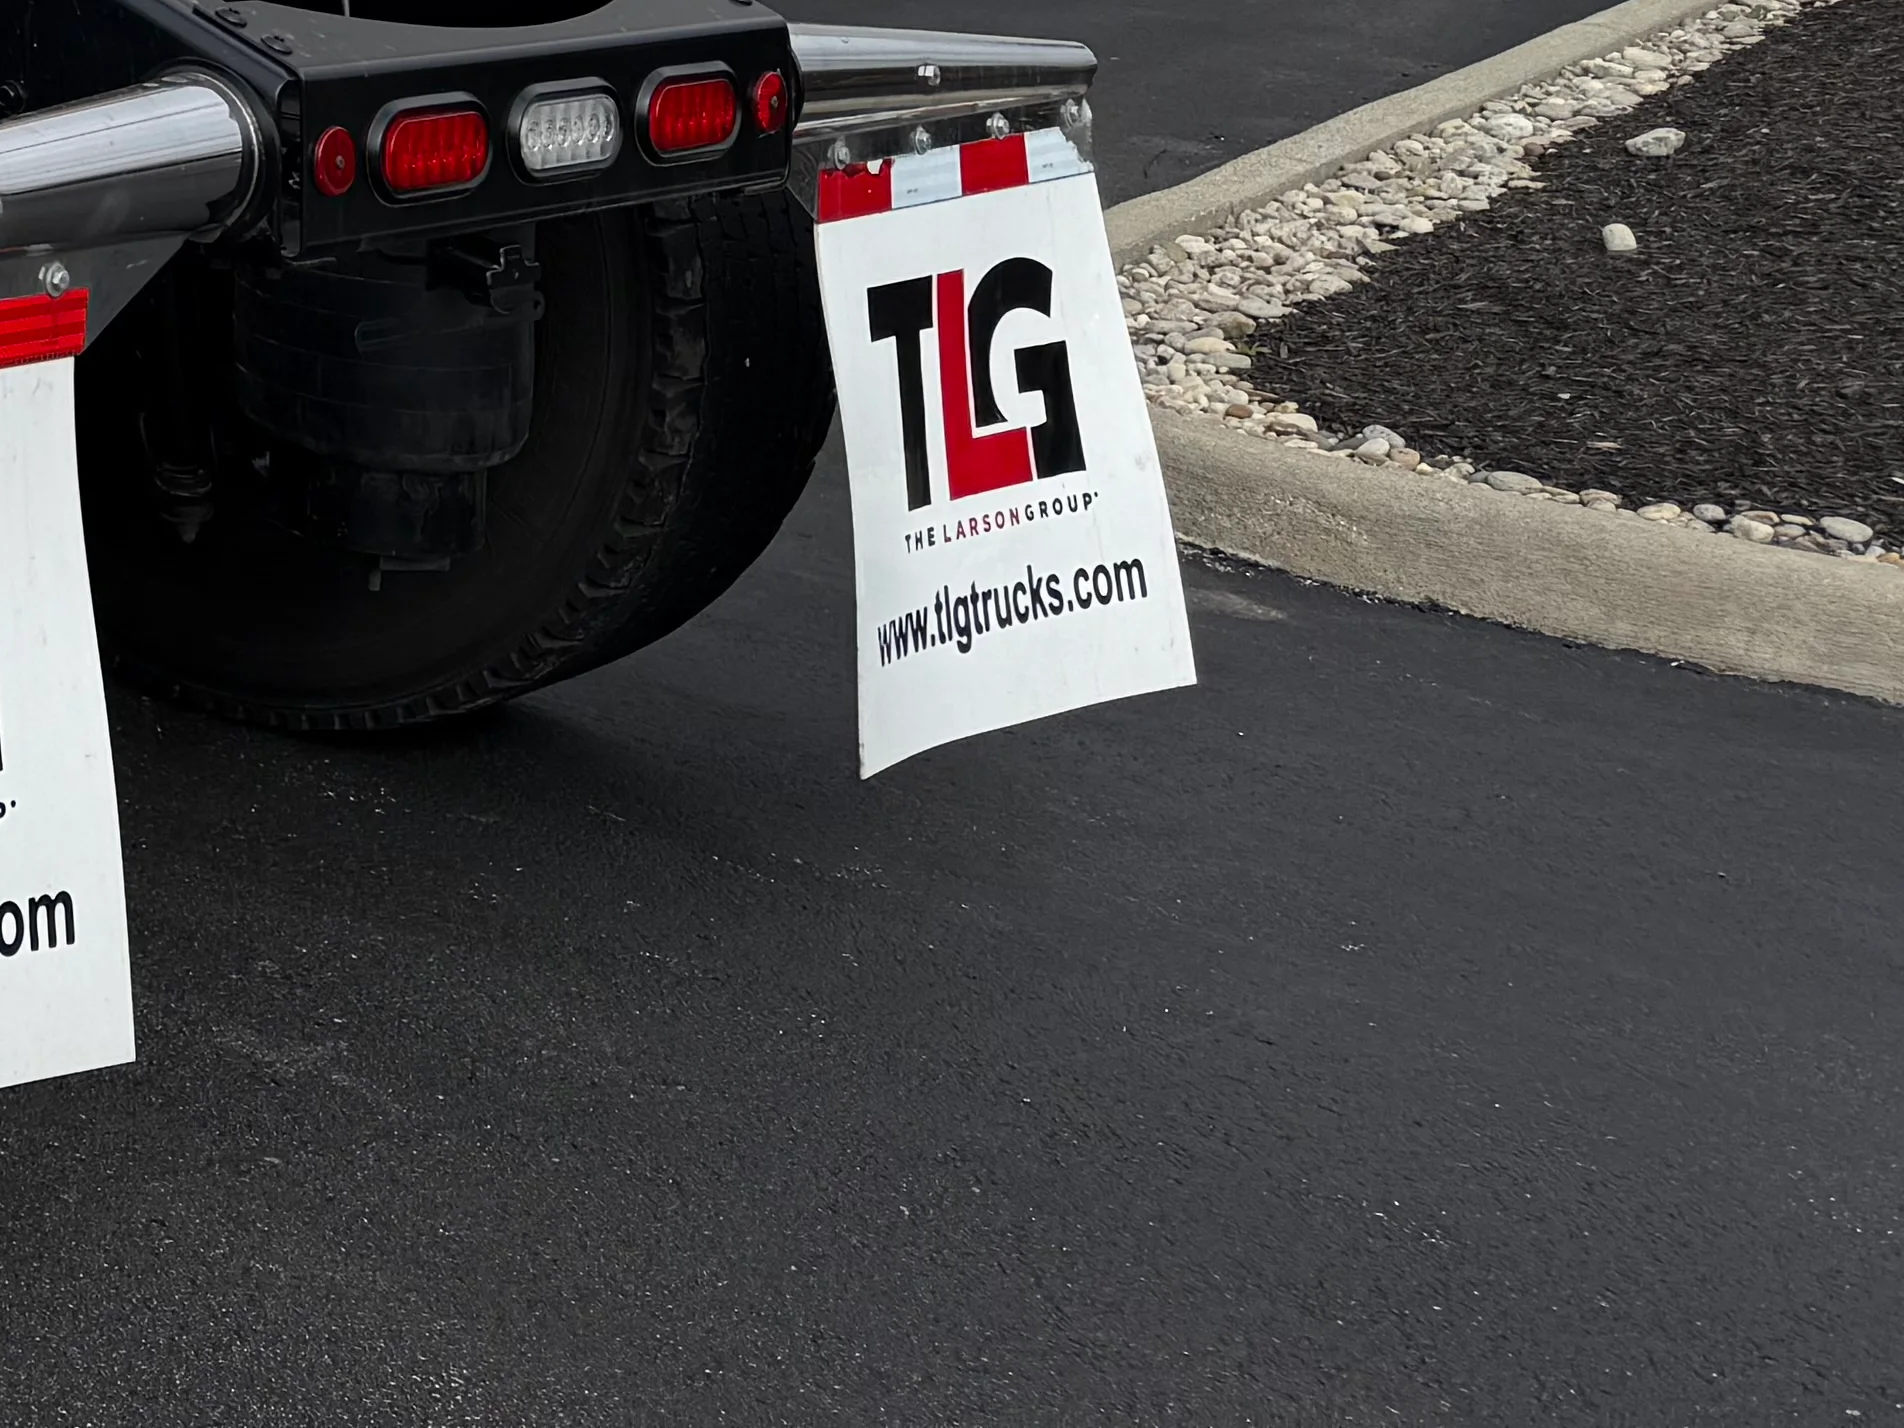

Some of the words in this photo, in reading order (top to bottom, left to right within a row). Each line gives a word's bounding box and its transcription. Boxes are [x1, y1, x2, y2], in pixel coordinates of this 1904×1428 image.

[867, 257, 1086, 511] TLG
[904, 527, 936, 553] THE
[943, 509, 1021, 545] LARSON
[877, 556, 1149, 668] www.tlgtrucks.com
